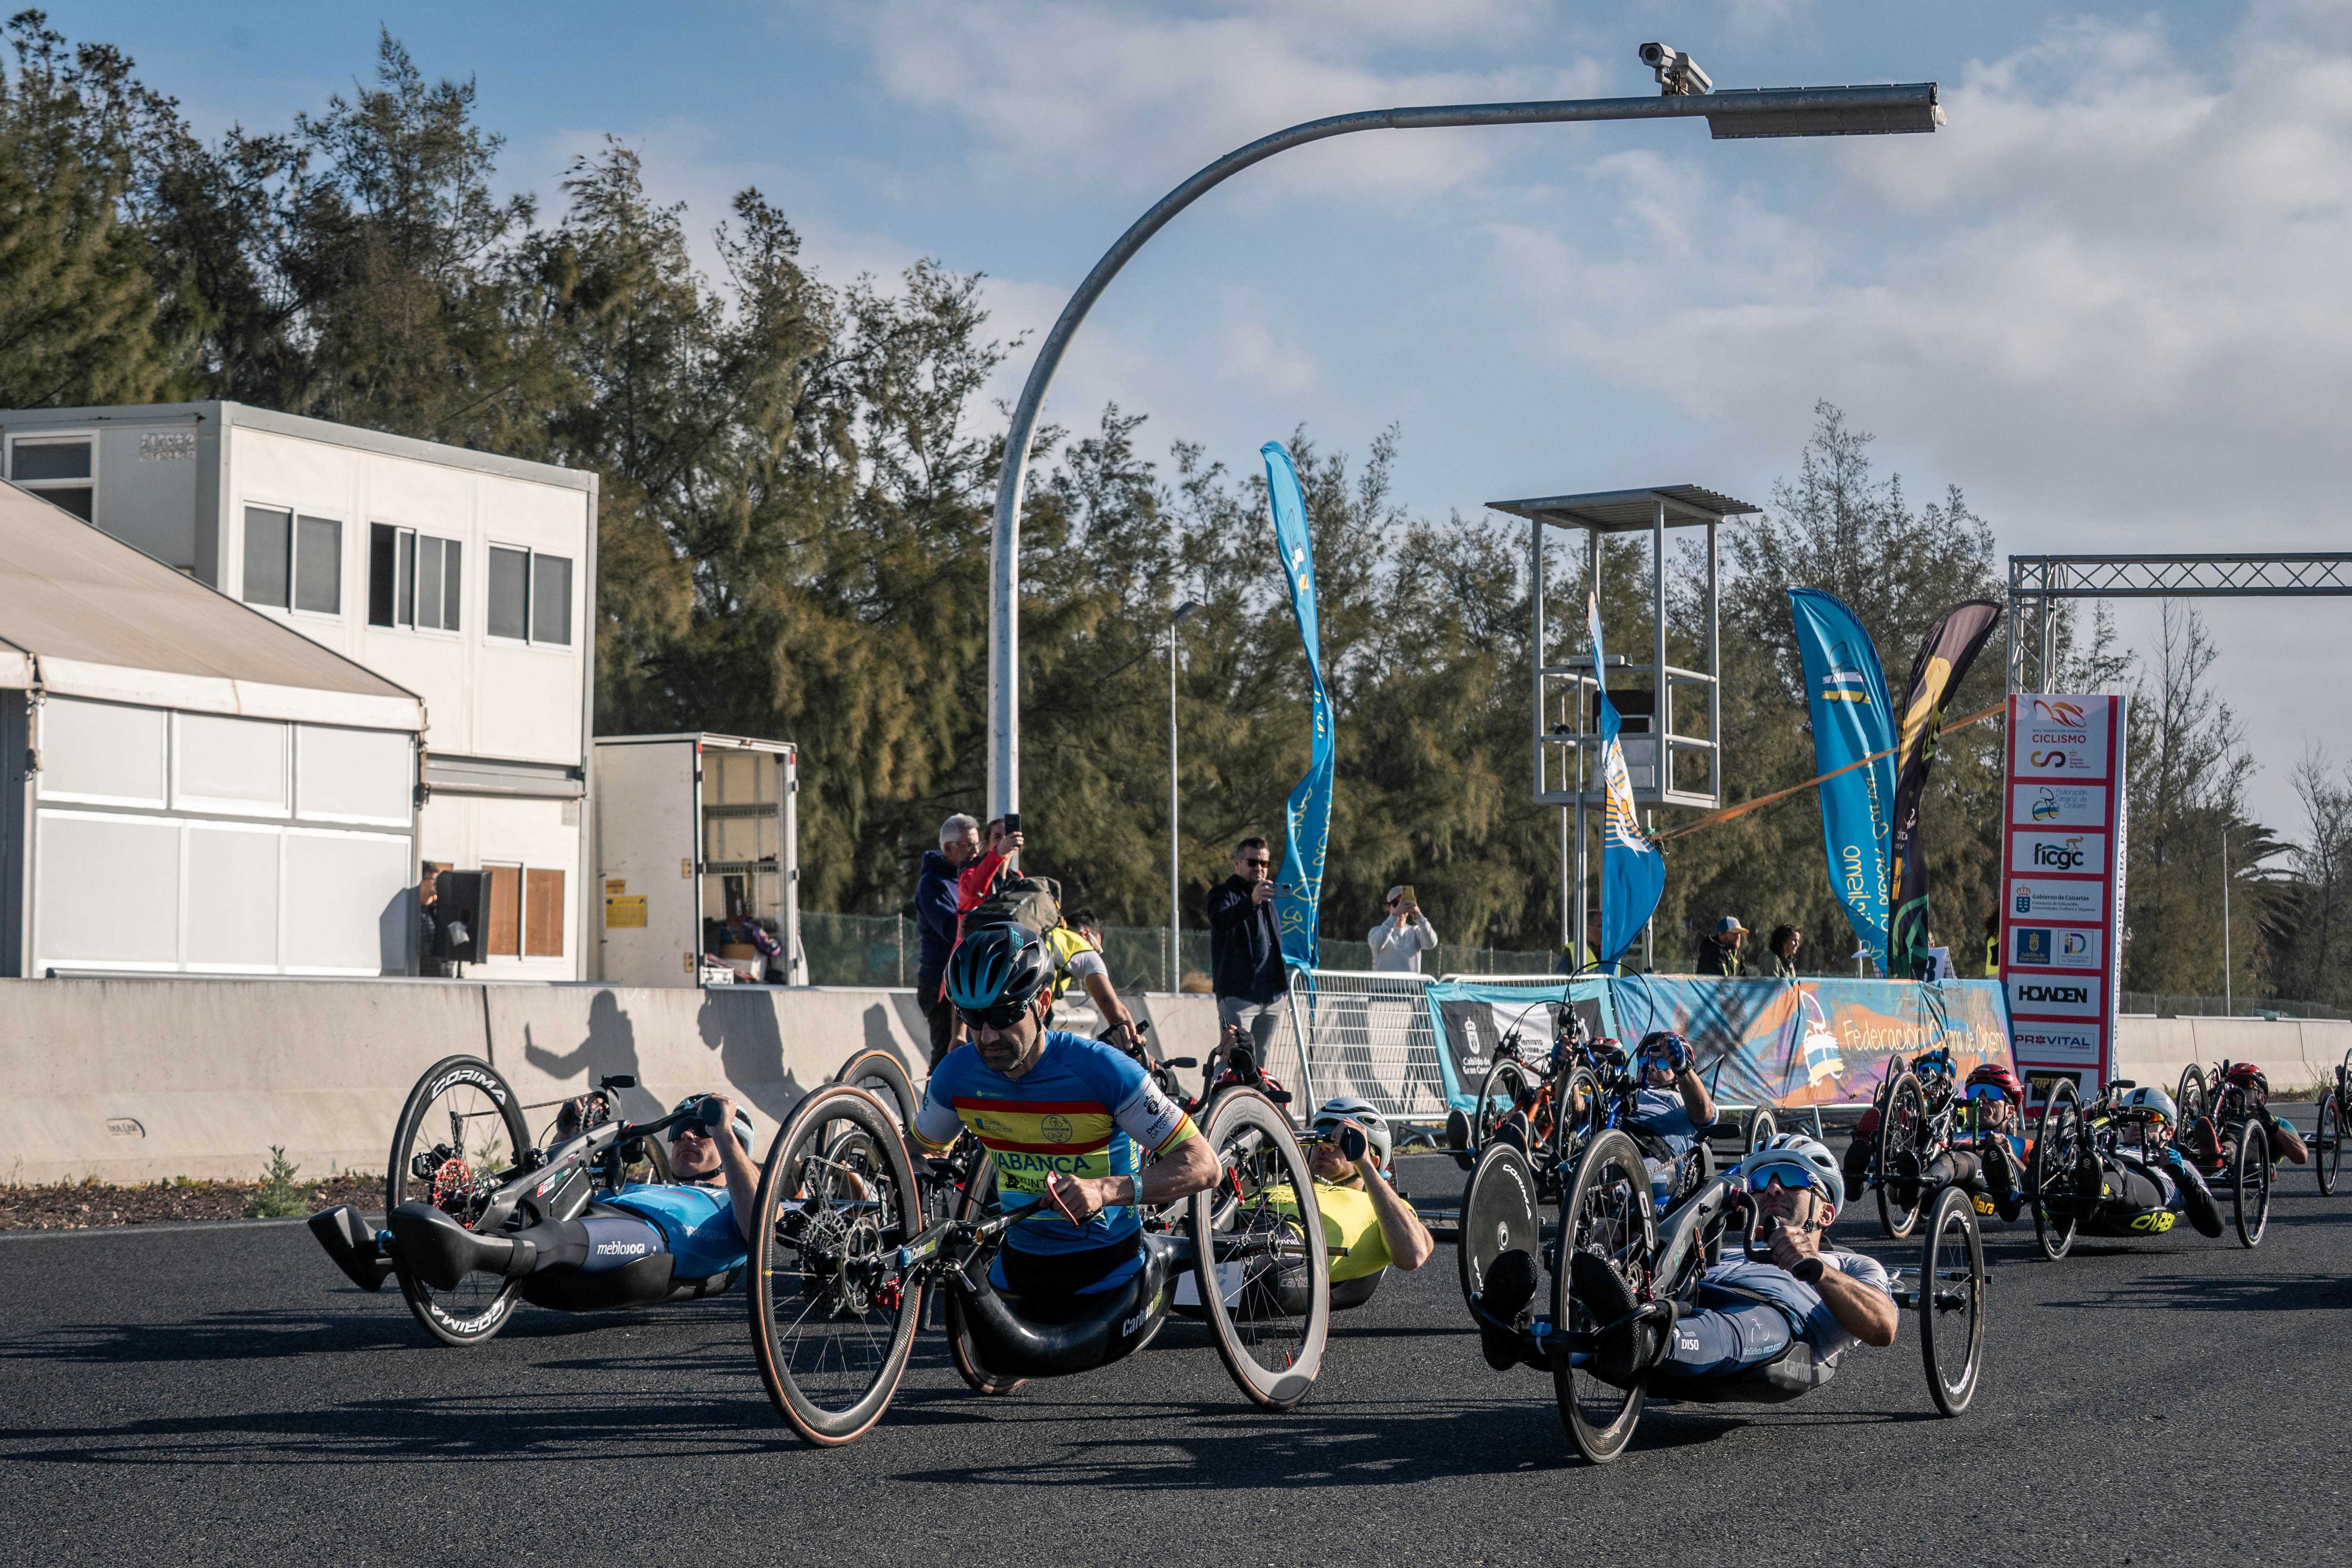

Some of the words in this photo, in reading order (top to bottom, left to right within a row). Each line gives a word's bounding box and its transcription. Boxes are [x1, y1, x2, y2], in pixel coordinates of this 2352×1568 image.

[2032, 734, 2086, 744] CICLISMO
[2056, 788, 2088, 796] Federación
[2034, 842, 2084, 870] ficgc
[1010, 927, 1024, 949] ET
[2019, 985, 2087, 1003] HOWDEN
[1843, 1019, 1926, 1051] Federación
[1966, 1022, 1975, 1053] de
[1462, 1056, 1484, 1066] Cabildo
[1484, 1056, 1491, 1066] de
[1462, 1065, 1477, 1075] Gran
[432, 1070, 506, 1105] CORIMA
[1150, 1129, 1160, 1140] DA
[997, 1153, 1092, 1174] ABANCA
[1503, 1164, 1532, 1220] CORIMA
[431, 1300, 505, 1333] CORIMA
